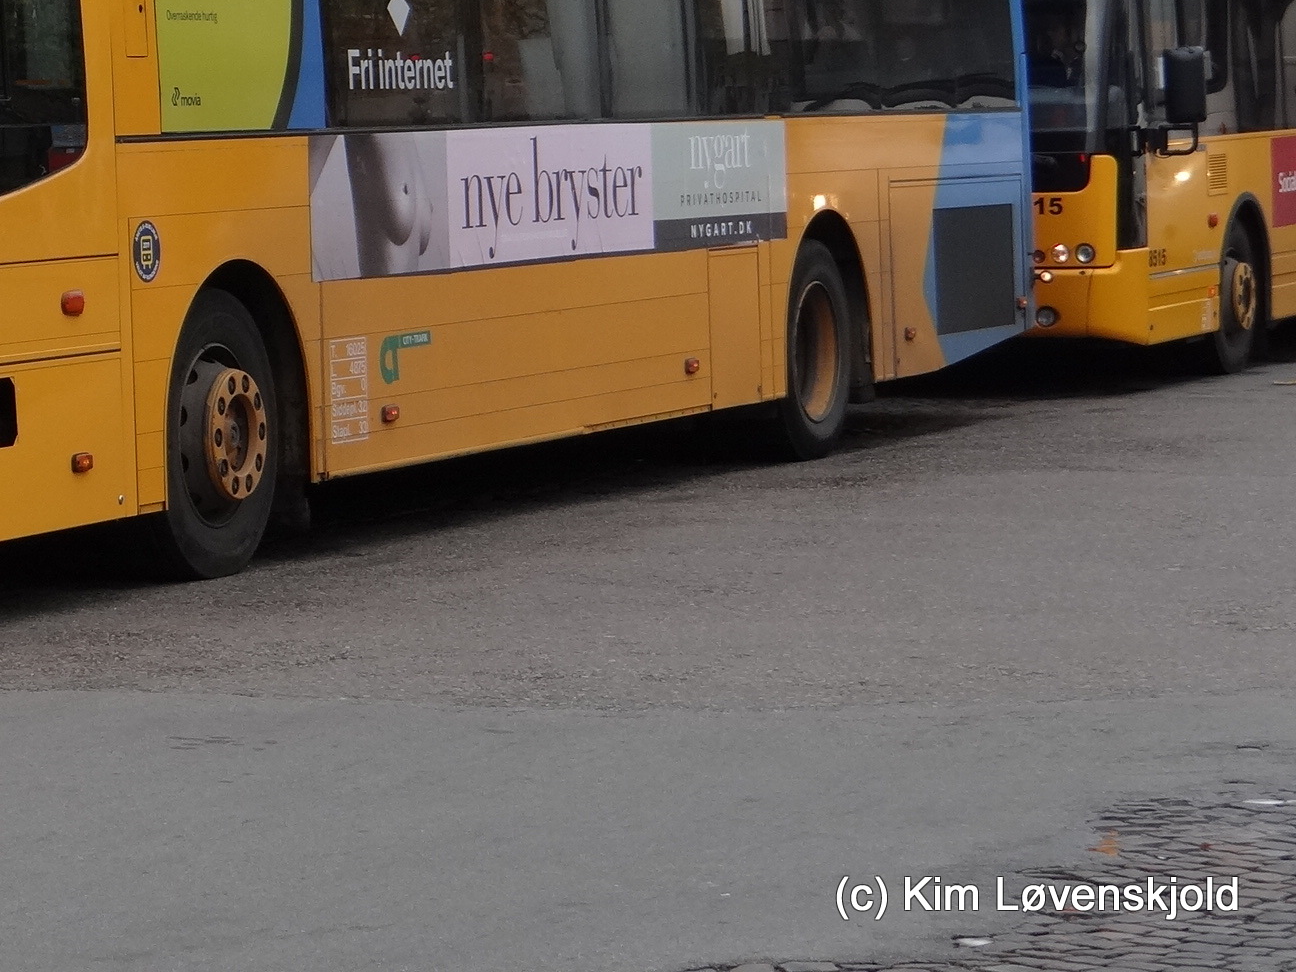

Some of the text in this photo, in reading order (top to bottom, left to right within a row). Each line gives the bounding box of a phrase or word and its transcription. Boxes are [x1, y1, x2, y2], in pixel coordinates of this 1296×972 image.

[347, 48, 454, 91] Fri internet
[181, 93, 202, 107] movia
[689, 129, 752, 189] nygart
[461, 135, 643, 259] nye bryster
[680, 190, 762, 207] PRIVATHOSPITAL
[690, 220, 753, 238] NYGART.DK
